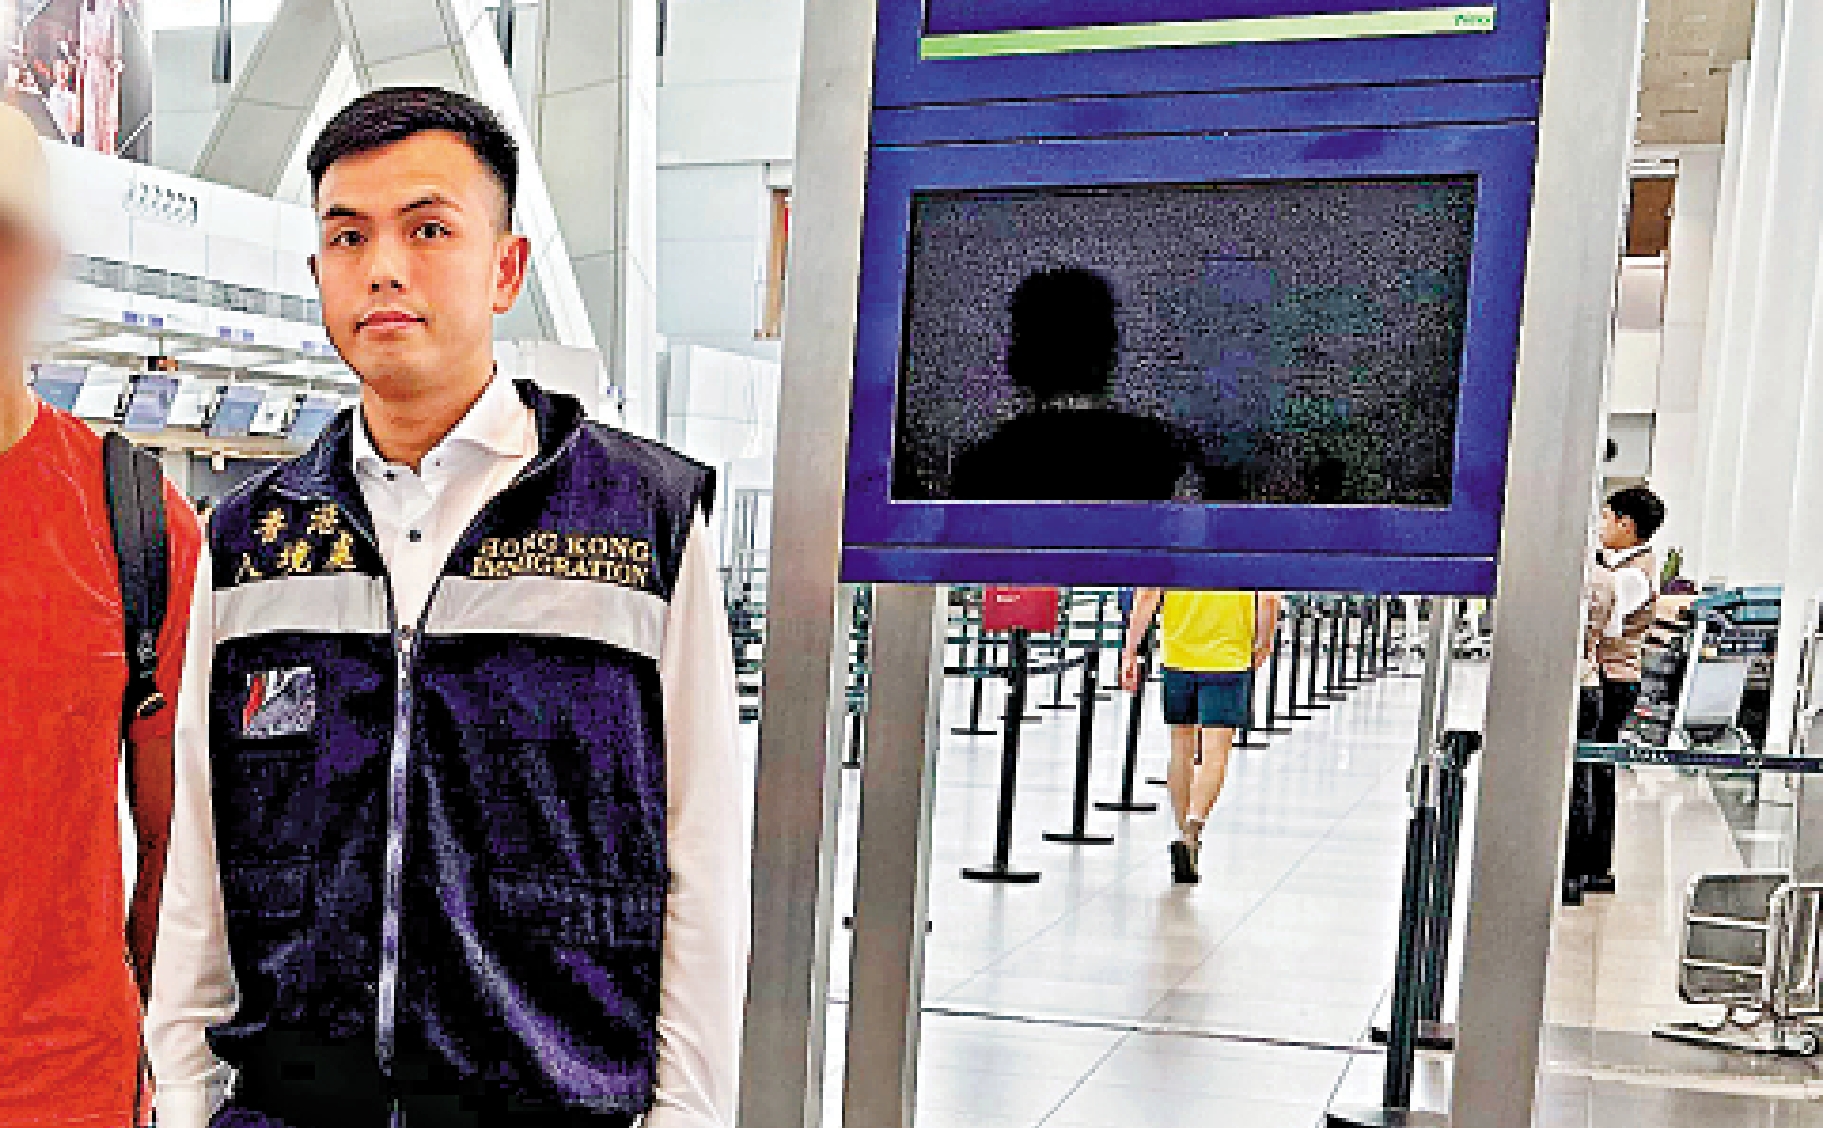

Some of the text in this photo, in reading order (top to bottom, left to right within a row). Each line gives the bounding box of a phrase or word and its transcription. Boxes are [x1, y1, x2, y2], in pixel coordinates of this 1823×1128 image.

[479, 533, 649, 562] HONG KONG
[471, 553, 648, 587] IMMIGRATION
